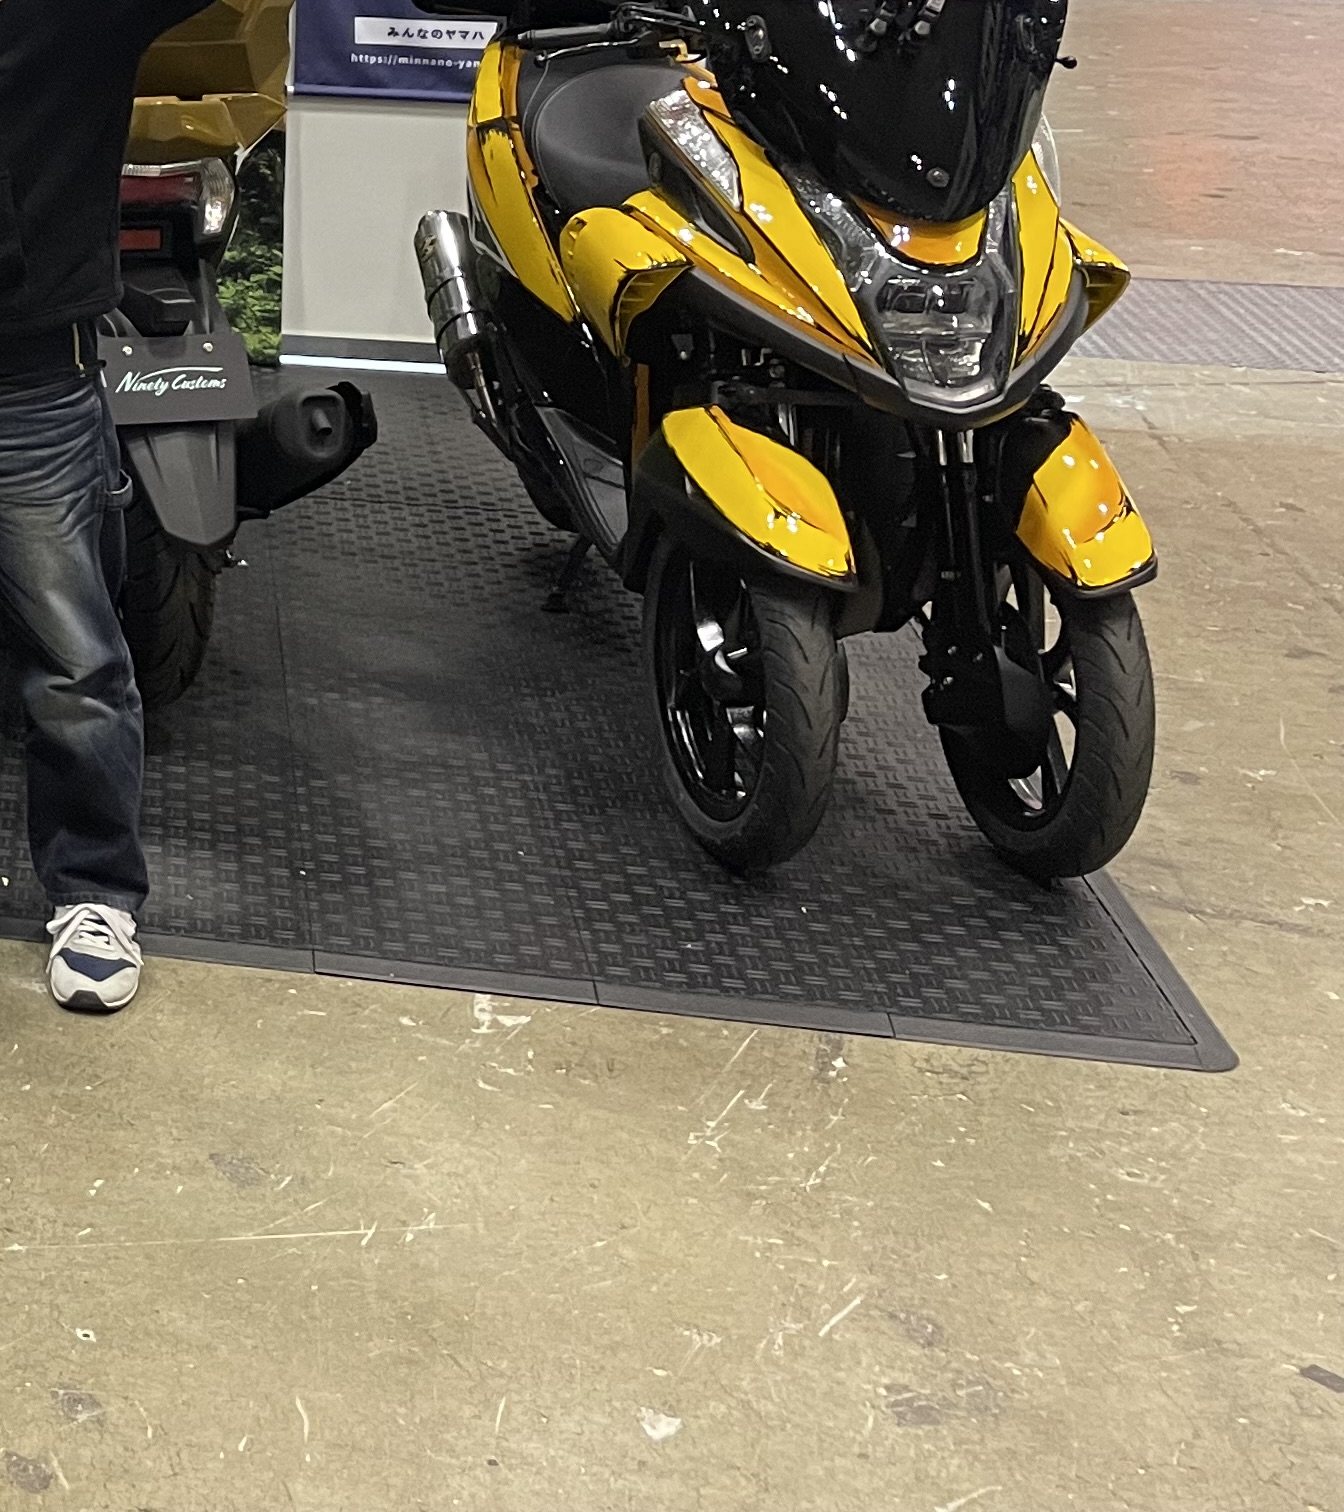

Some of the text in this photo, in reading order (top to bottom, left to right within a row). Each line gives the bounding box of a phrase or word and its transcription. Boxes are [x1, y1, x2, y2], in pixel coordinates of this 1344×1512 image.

[386, 26, 485, 40] みんなのヤマハ
